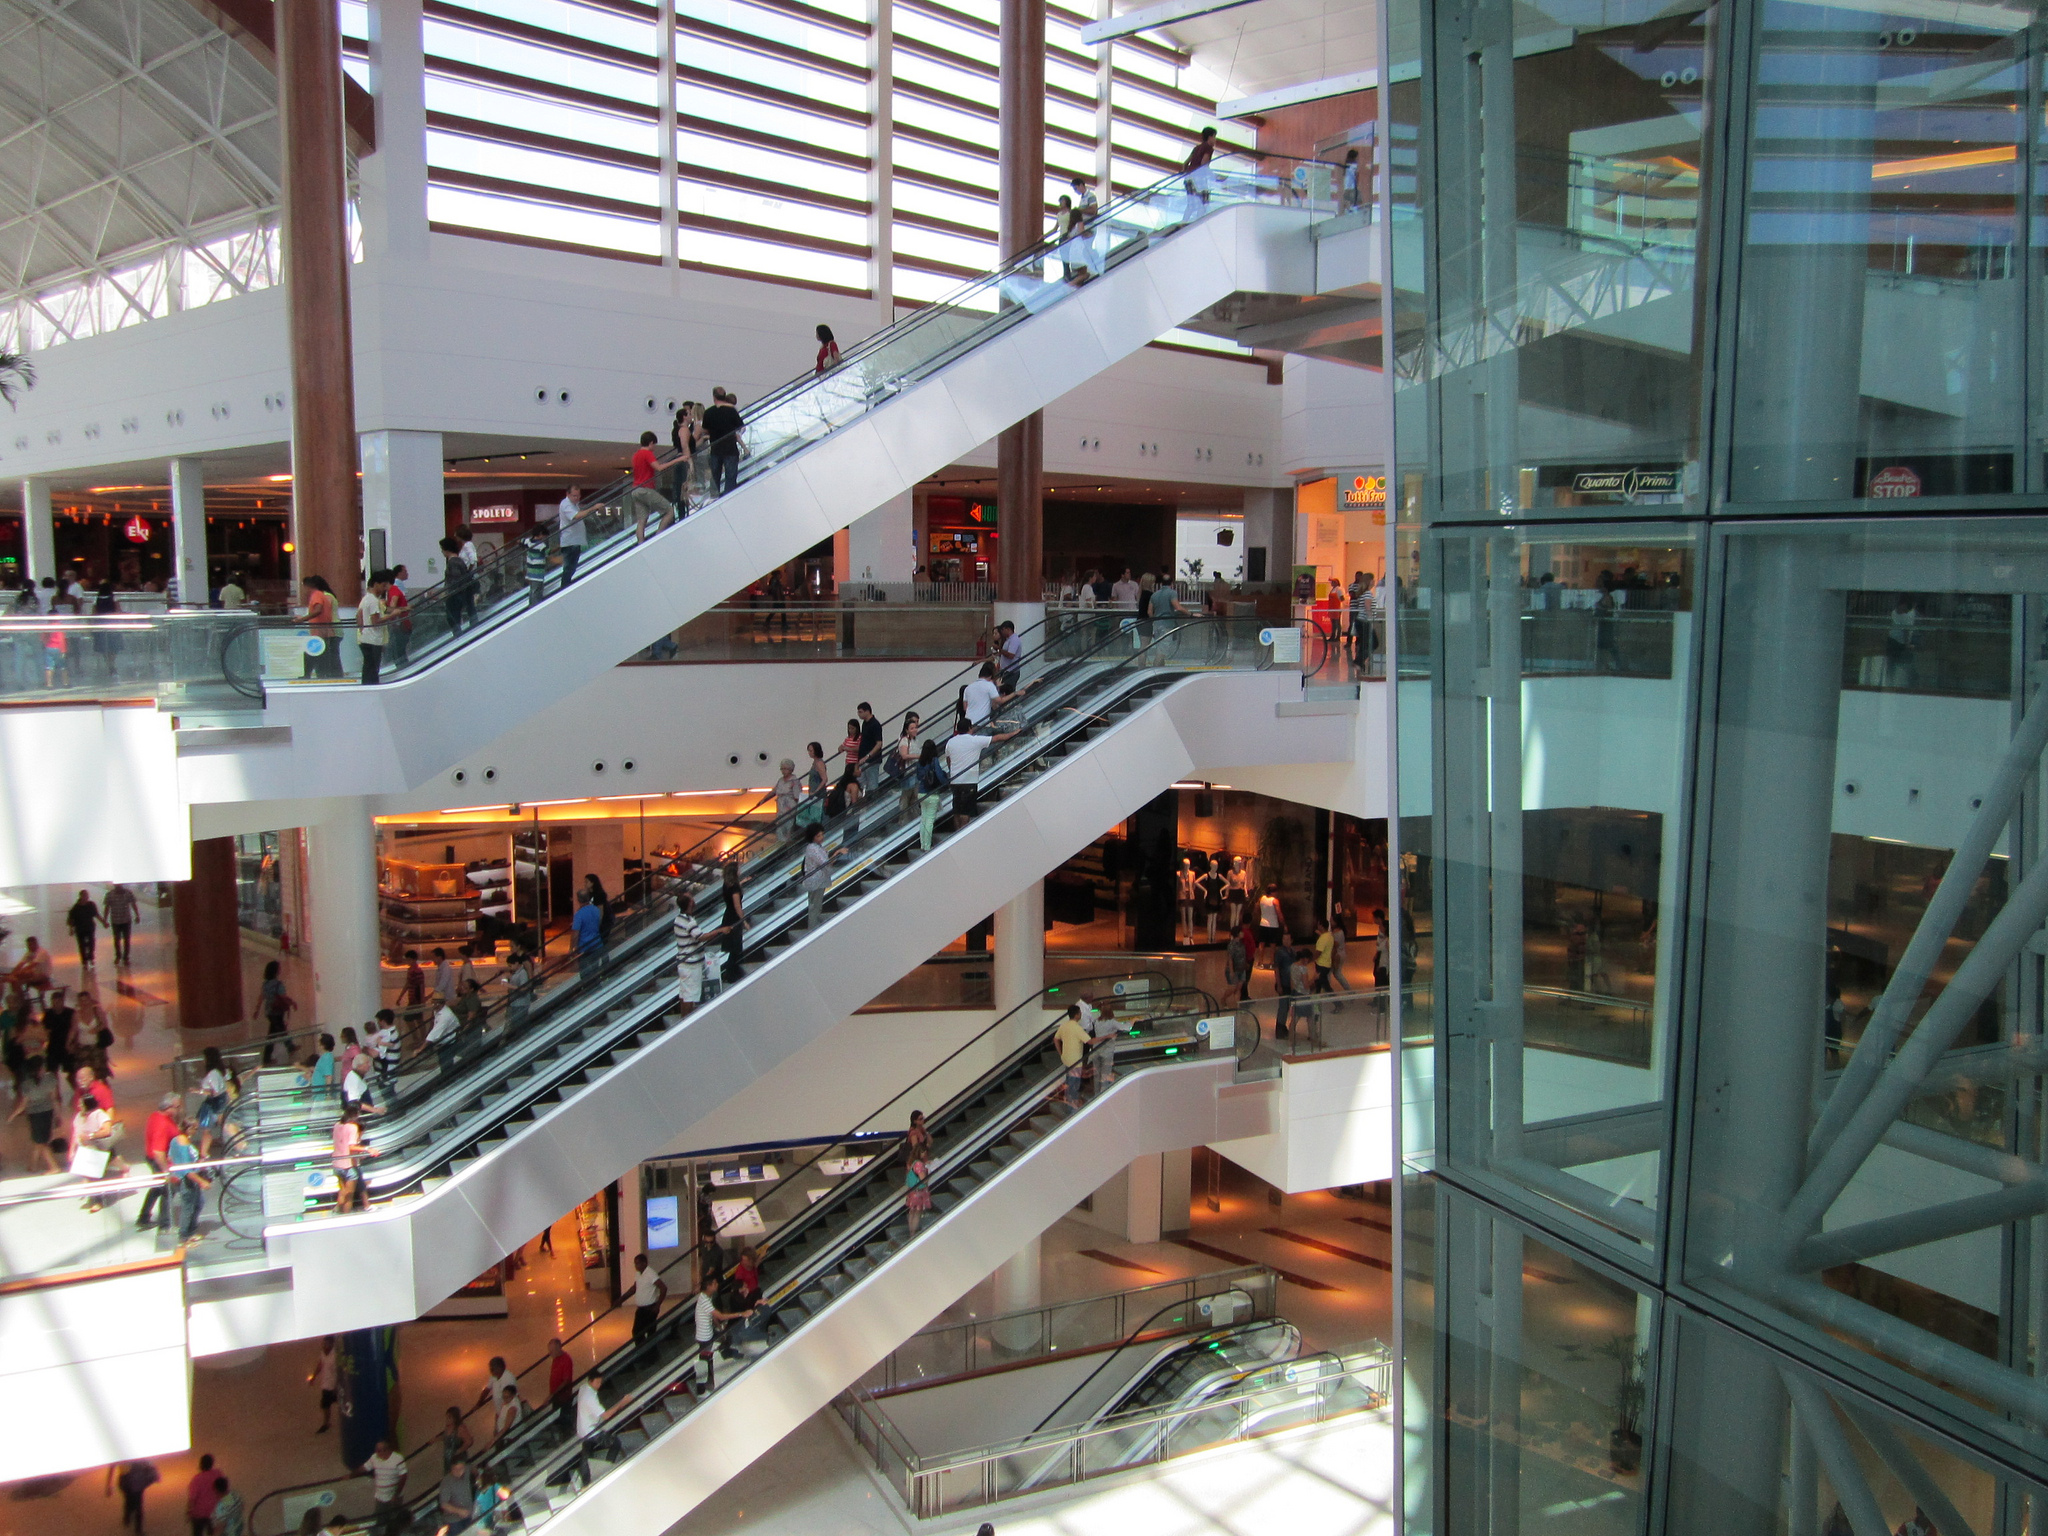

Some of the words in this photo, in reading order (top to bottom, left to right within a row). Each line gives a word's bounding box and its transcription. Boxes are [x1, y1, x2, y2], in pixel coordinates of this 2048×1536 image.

[1579, 476, 1620, 489] Quanto
[1639, 474, 1673, 487] Prima
[1873, 484, 1916, 498] STOP
[473, 508, 514, 519] SPOLETO
